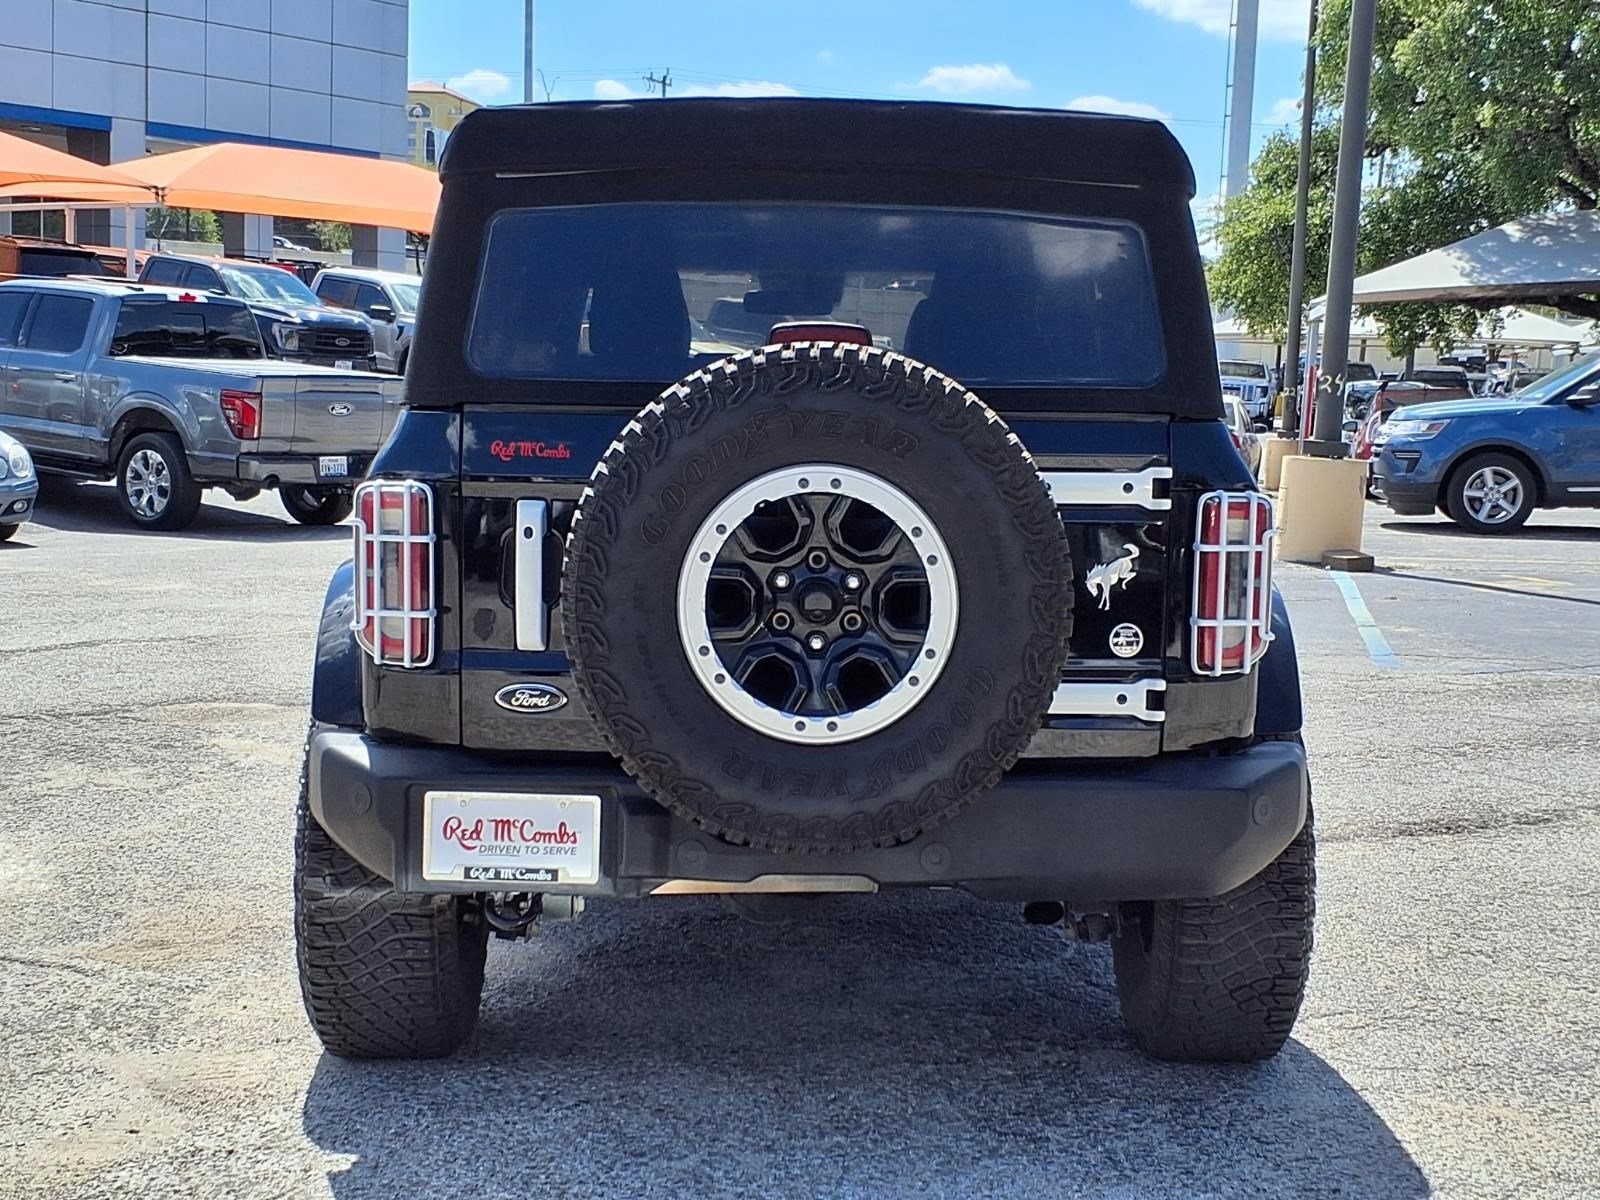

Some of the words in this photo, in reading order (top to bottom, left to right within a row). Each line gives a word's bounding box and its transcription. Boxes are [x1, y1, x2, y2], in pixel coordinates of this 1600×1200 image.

[1320, 373, 1345, 396] 24
[491, 440, 516, 461] Red
[517, 441, 570, 458] McCombs
[511, 689, 551, 706] Ford
[443, 816, 484, 850] Red
[487, 819, 577, 845] McCombs
[478, 845, 521, 855] DRIVEN
[524, 846, 540, 855] TO
[542, 847, 577, 856] SERVE
[470, 867, 496, 880] Red
[499, 868, 552, 881] McCombs
